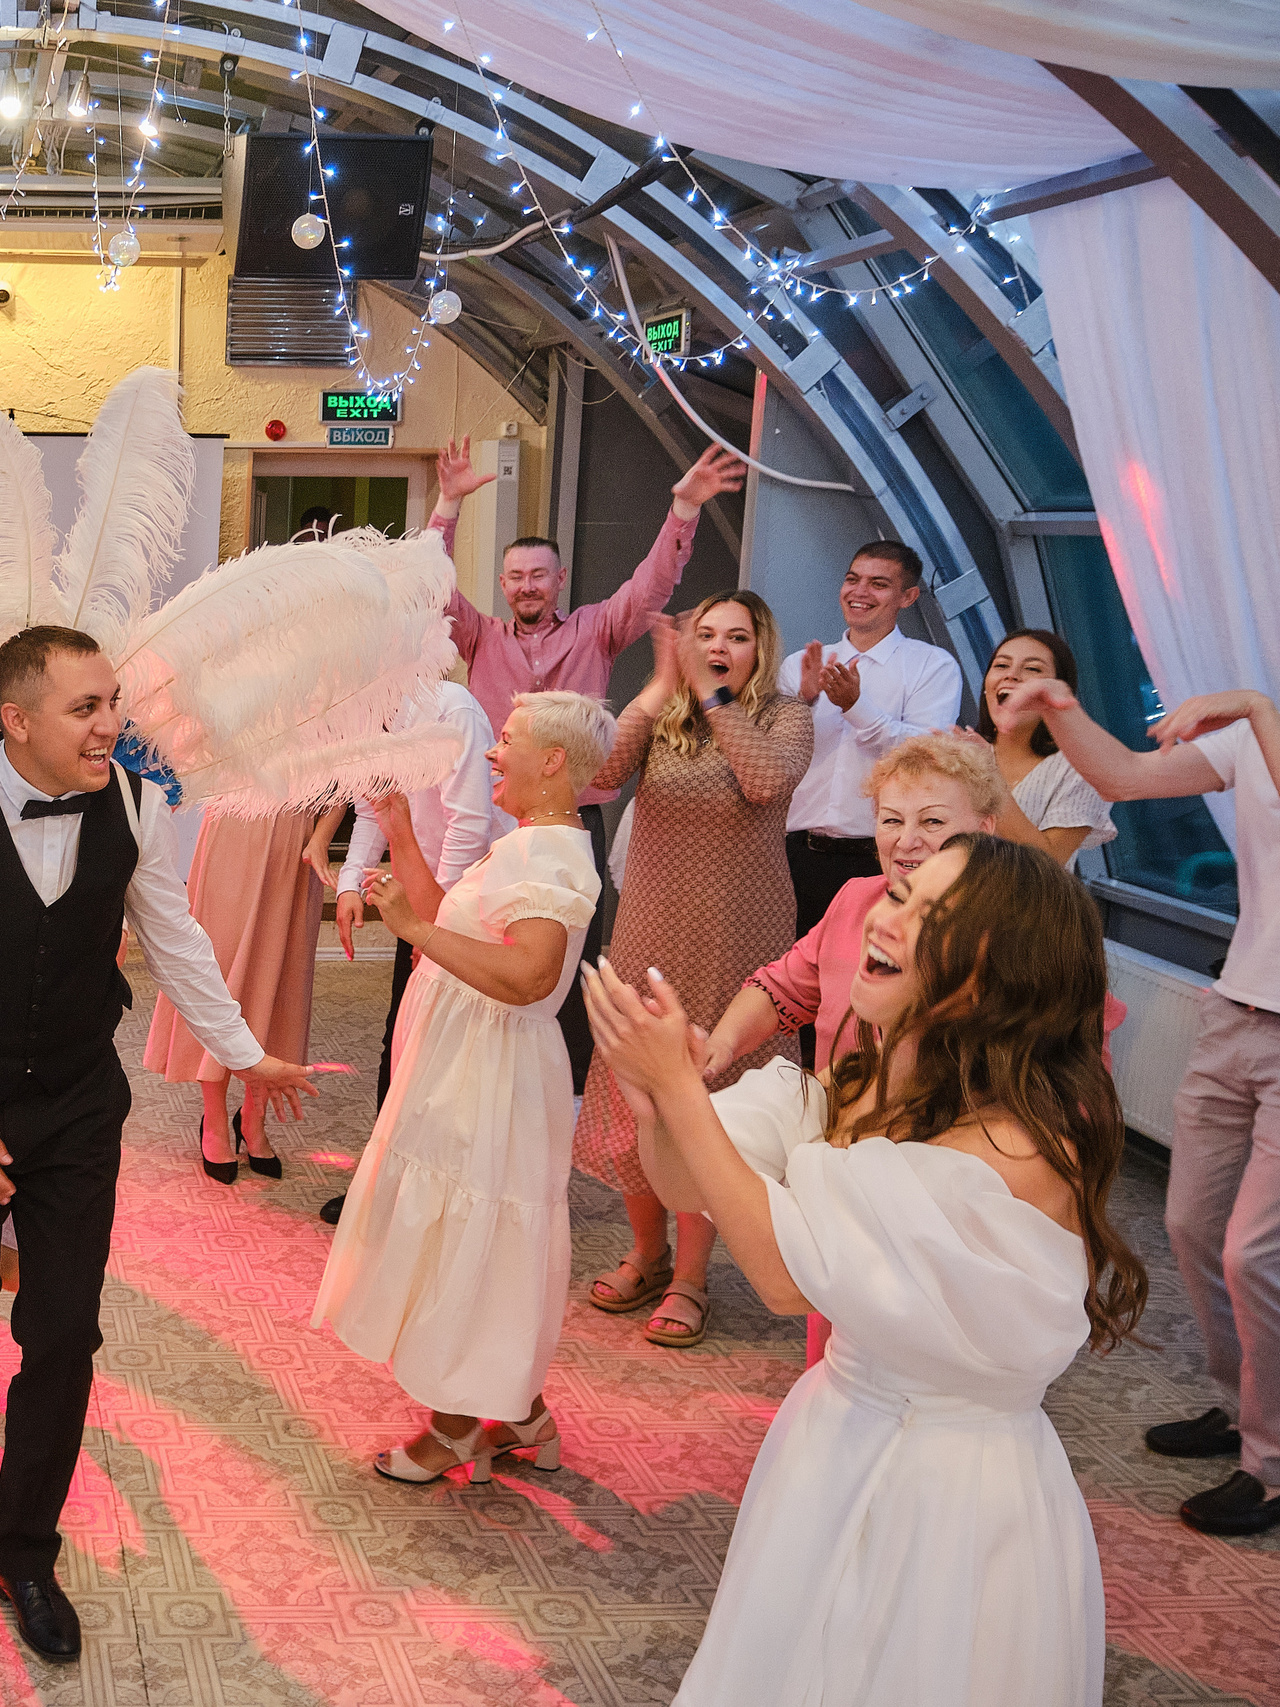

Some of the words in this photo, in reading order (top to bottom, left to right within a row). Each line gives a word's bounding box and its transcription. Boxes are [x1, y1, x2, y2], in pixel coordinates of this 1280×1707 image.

[647, 320, 679, 341] ВЫХОД
[651, 338, 674, 352] EXIT
[327, 395, 391, 410] ВЫХОД
[336, 408, 381, 418] EXIT
[333, 430, 386, 443] ВЫХОД
